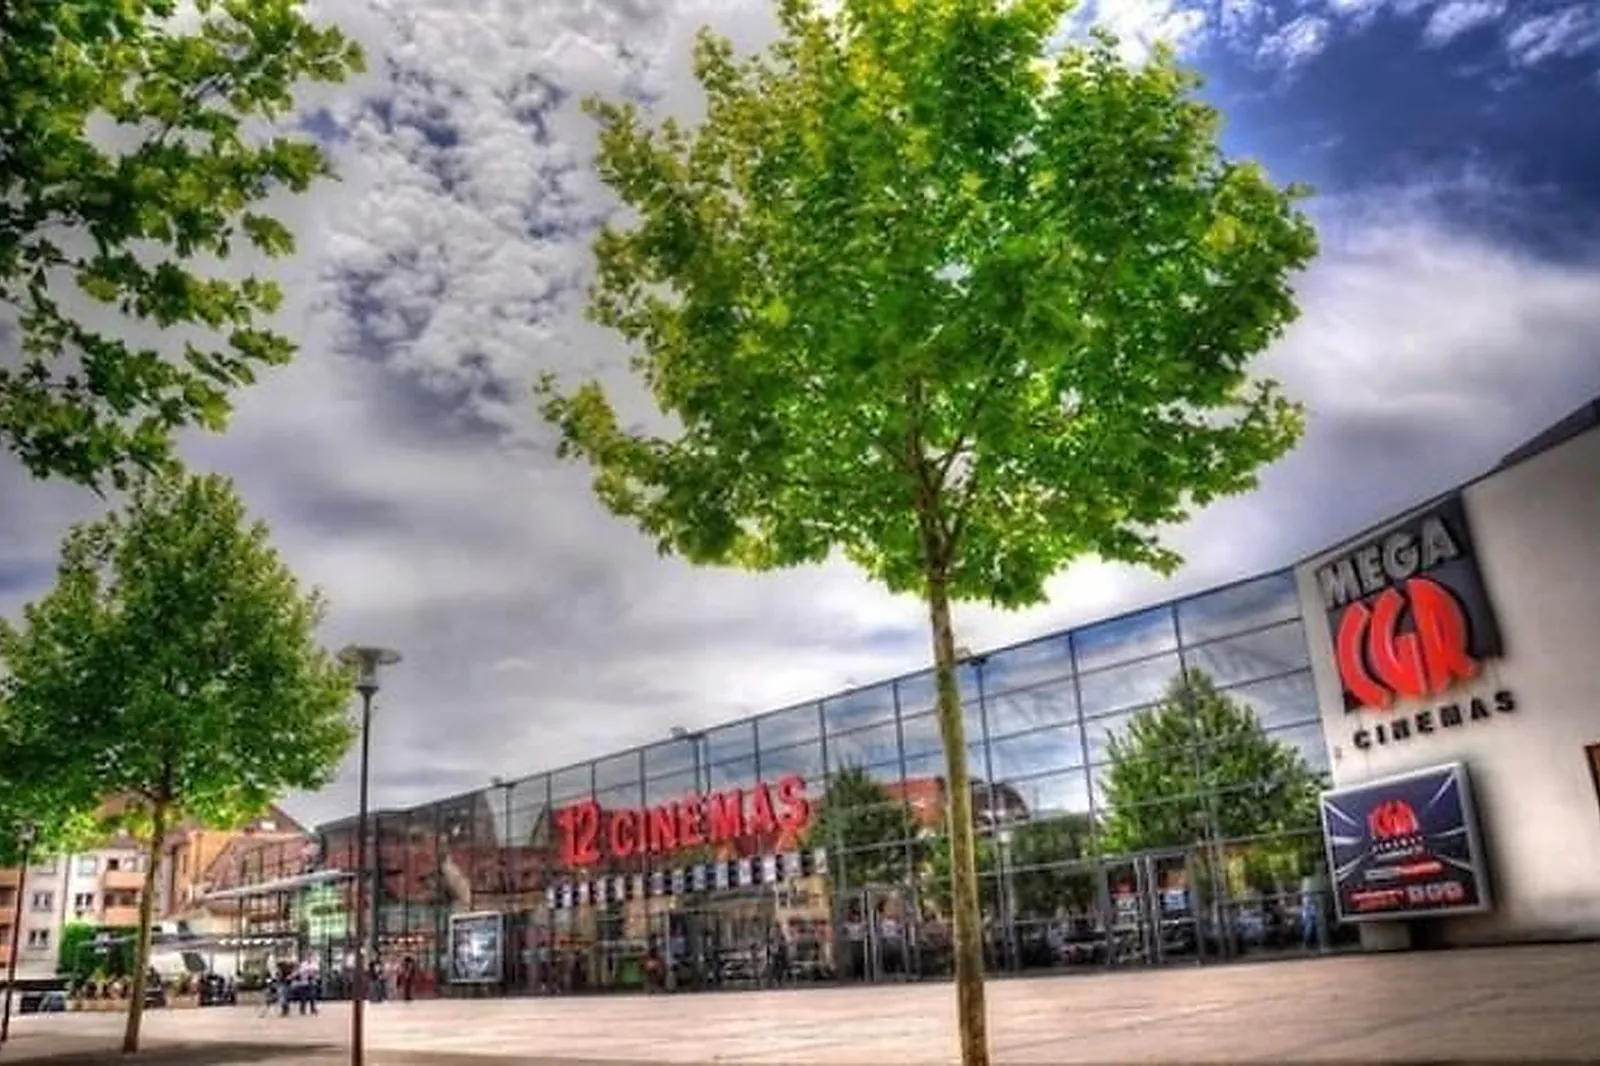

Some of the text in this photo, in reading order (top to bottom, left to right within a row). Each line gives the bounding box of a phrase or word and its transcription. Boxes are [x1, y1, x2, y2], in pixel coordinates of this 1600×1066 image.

[1318, 516, 1458, 603] MEGA
[1338, 576, 1474, 711] CGR
[1354, 691, 1516, 749] CINEMAS
[556, 774, 812, 866] 12 CINEMAS
